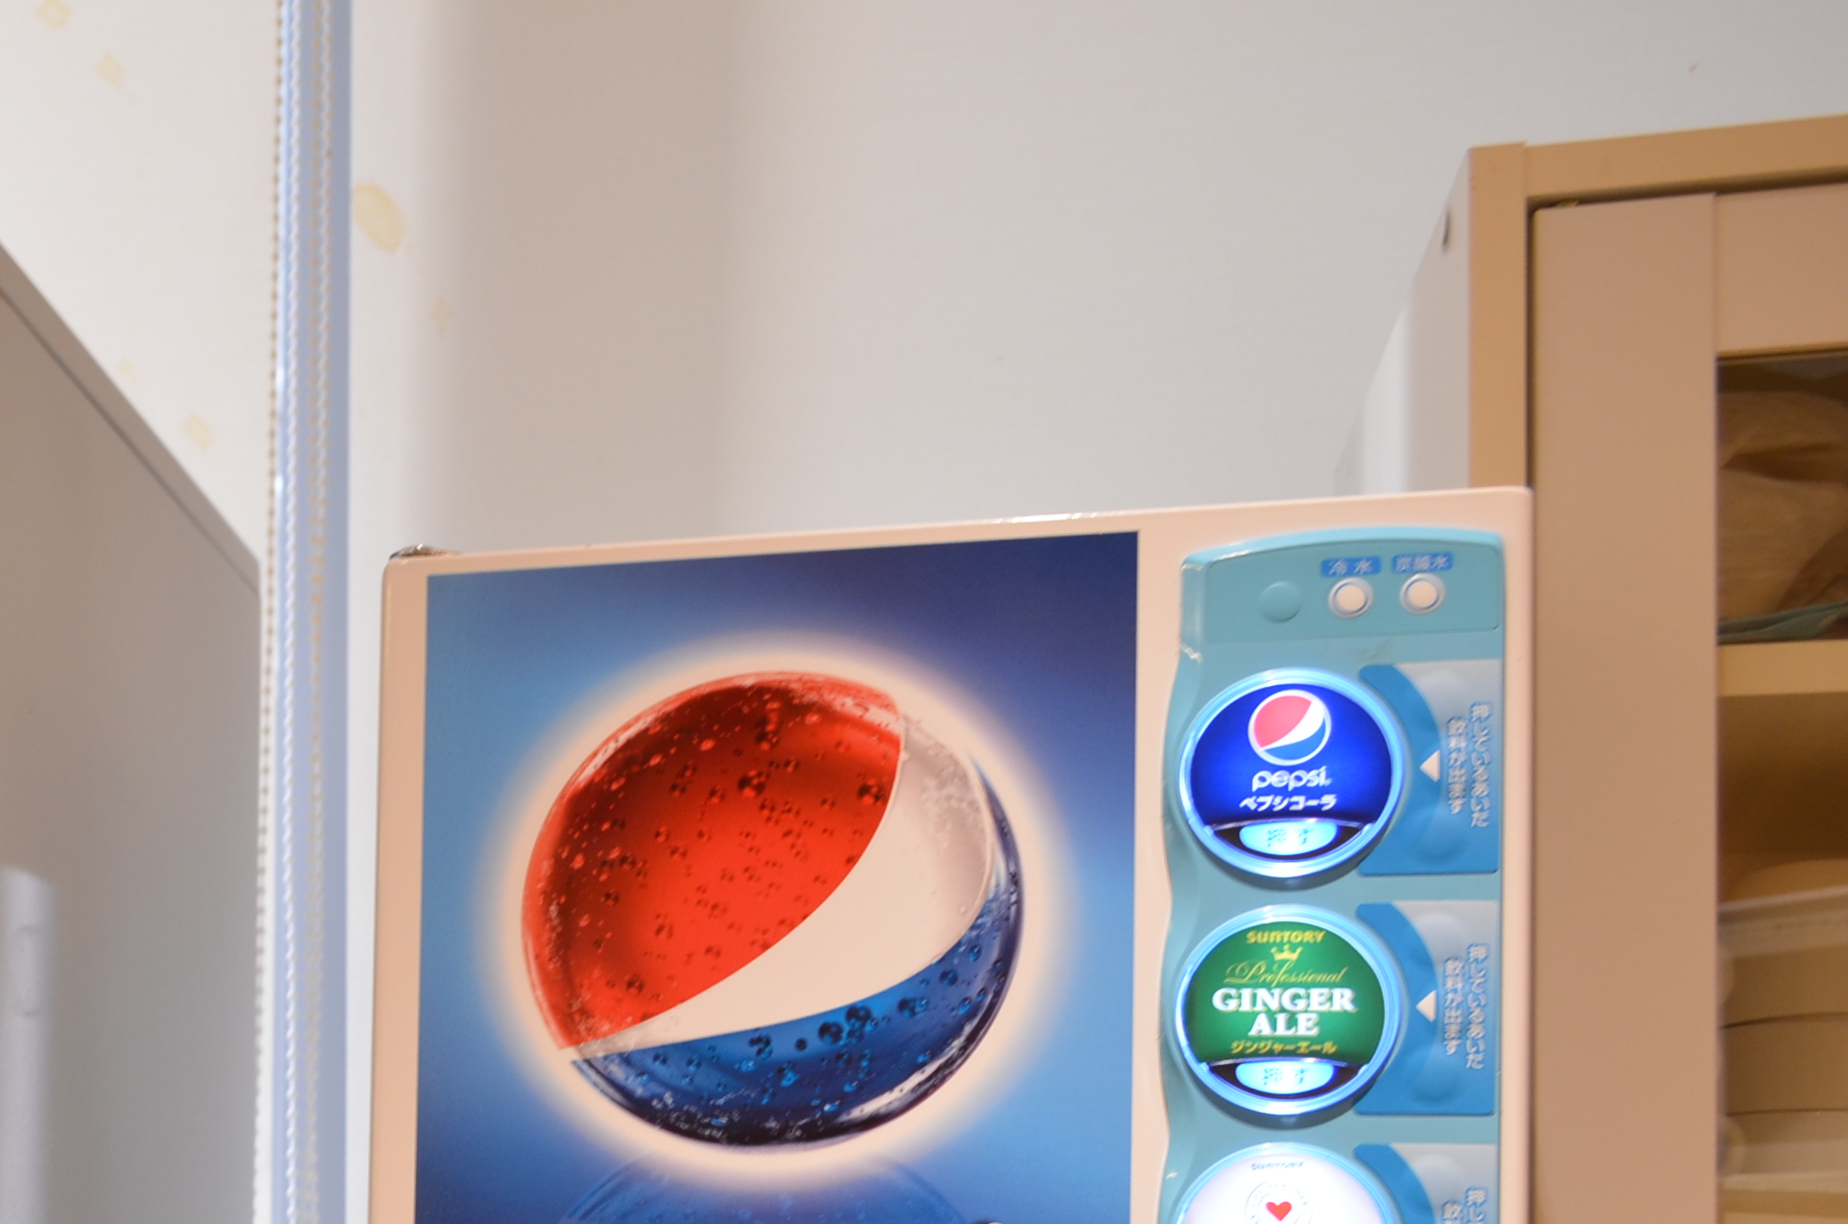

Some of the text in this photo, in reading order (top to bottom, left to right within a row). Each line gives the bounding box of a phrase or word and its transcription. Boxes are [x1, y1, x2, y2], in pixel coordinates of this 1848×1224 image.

[1252, 766, 1331, 792] pepsi
[1239, 794, 1337, 812] ペプシコーラ
[1246, 930, 1326, 944] SUNTORY
[1223, 959, 1349, 988] Professional
[1211, 987, 1358, 1012] GINGER
[1248, 1013, 1320, 1036] ALE
